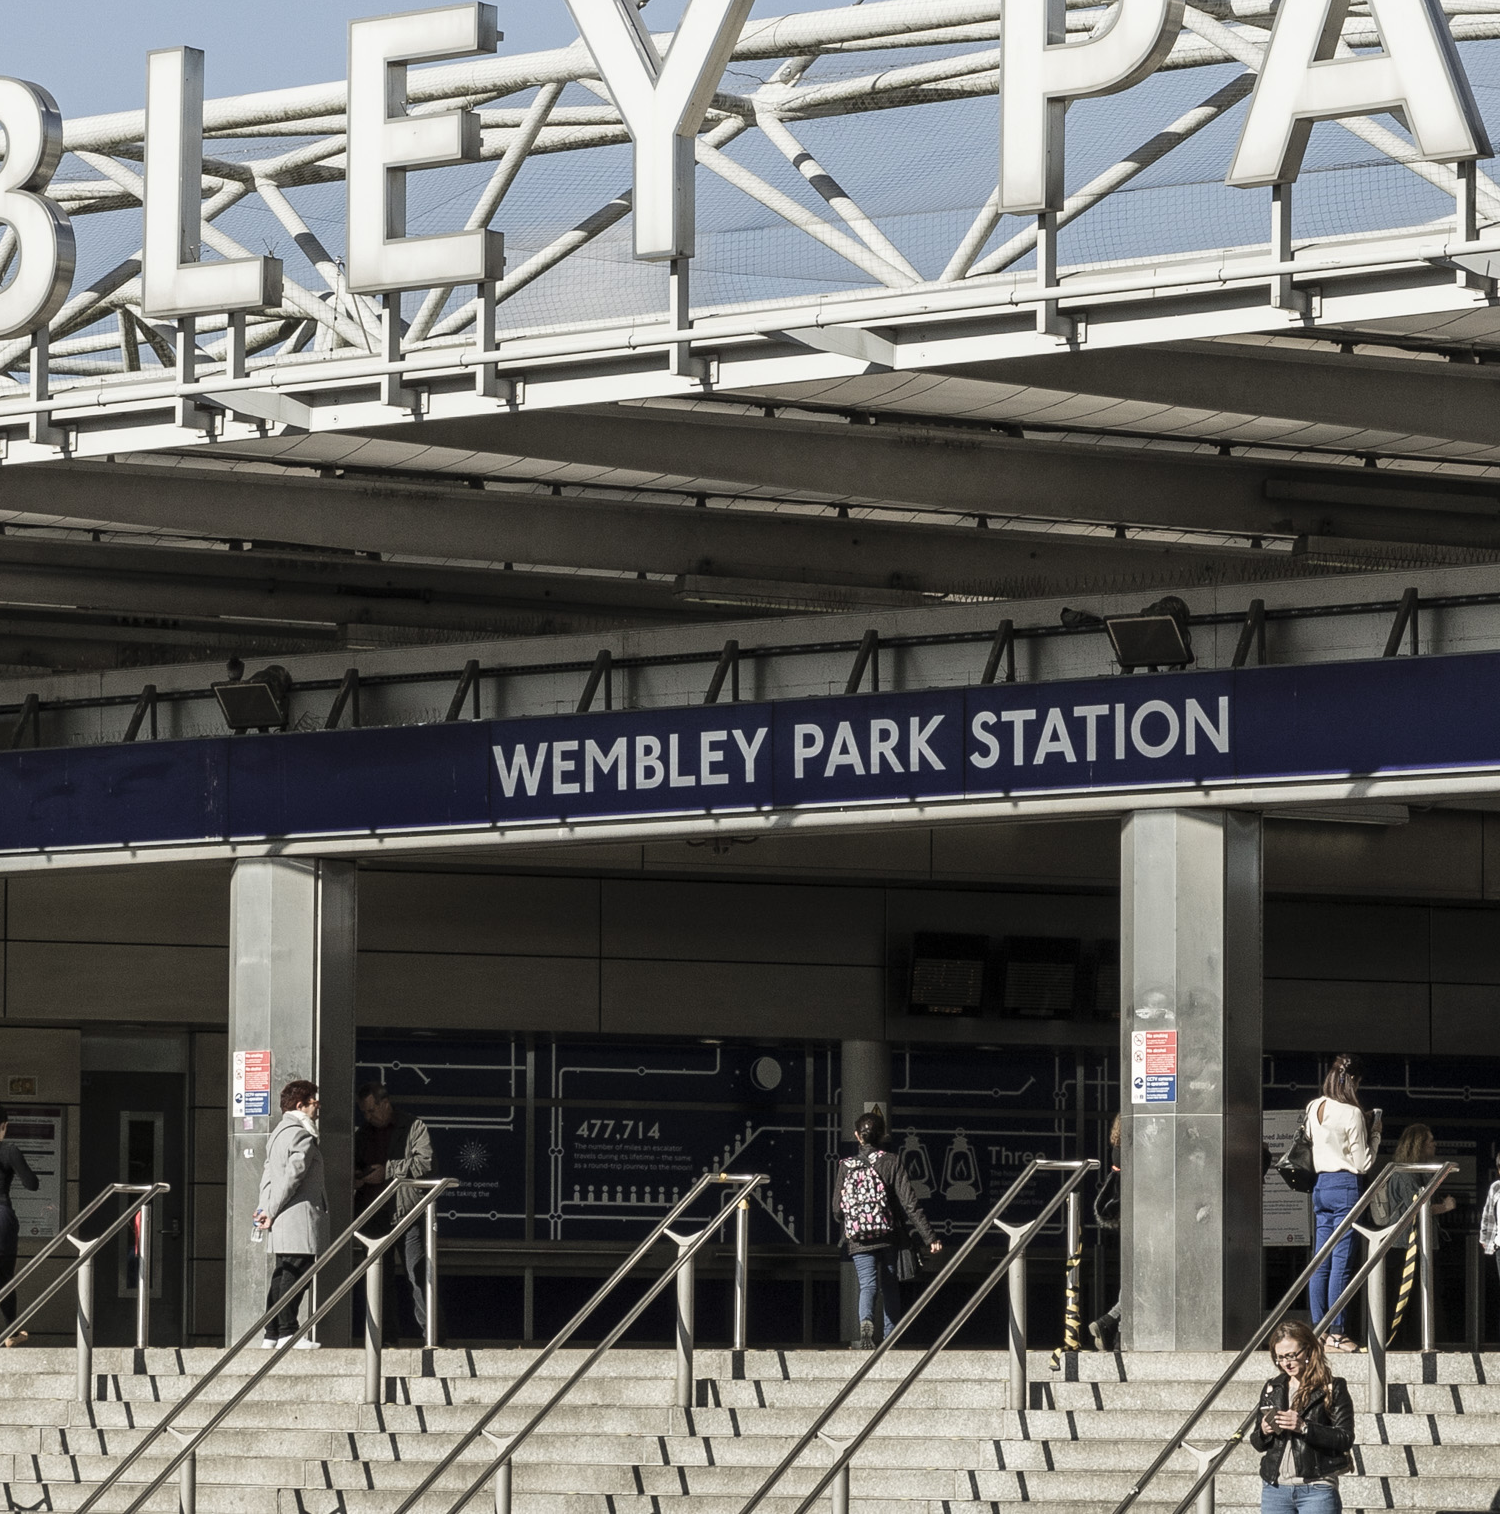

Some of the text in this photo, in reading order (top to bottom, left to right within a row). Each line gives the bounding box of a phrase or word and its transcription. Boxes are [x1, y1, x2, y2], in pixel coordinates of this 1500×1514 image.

[492, 696, 1229, 797] WEMBLEY PARK STATION
[576, 1119, 660, 1140] 477,714
[652, 1144, 682, 1152] escalator
[597, 1153, 618, 1161] during
[988, 1147, 1046, 1165] Three
[457, 1190, 477, 1198] taking
